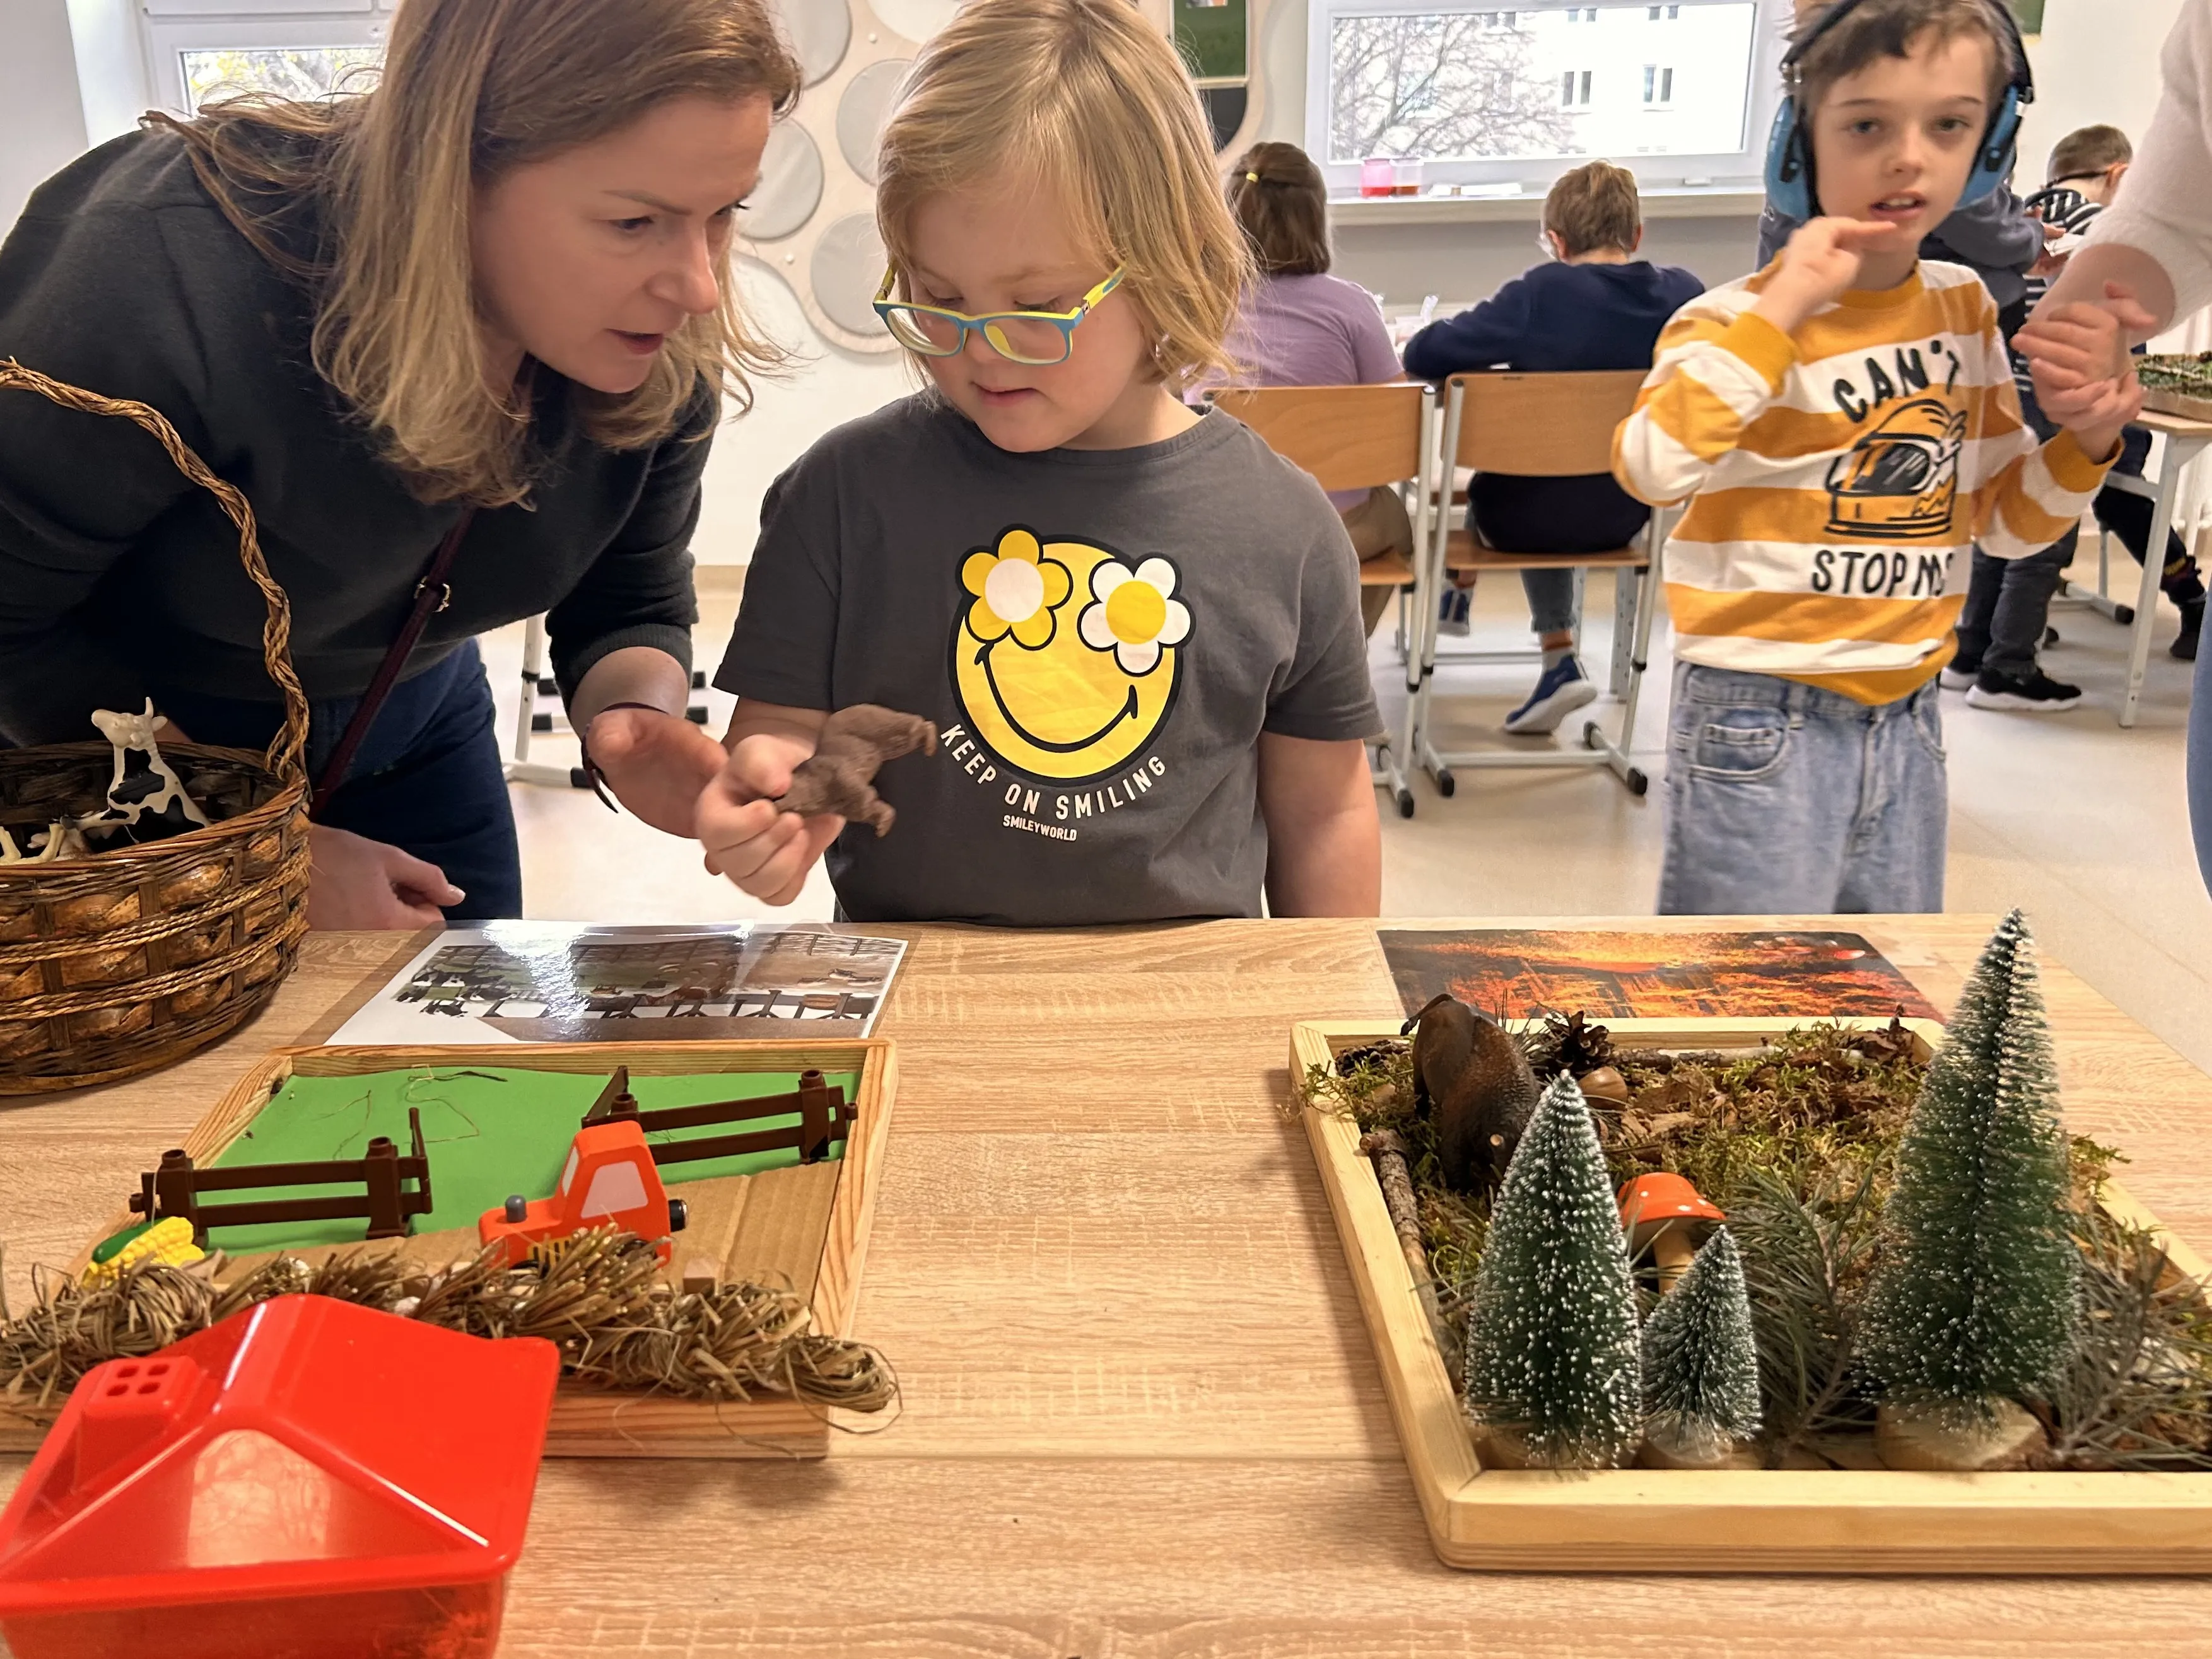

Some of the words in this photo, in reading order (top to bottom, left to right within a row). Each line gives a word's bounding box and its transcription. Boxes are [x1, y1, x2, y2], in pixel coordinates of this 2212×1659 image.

[1812, 549, 1908, 598] STOP
[940, 724, 998, 784] KEEP
[1004, 783, 1041, 815] ON
[1055, 756, 1166, 820] SMILING
[1003, 815, 1077, 841] SMILEYWORLD
